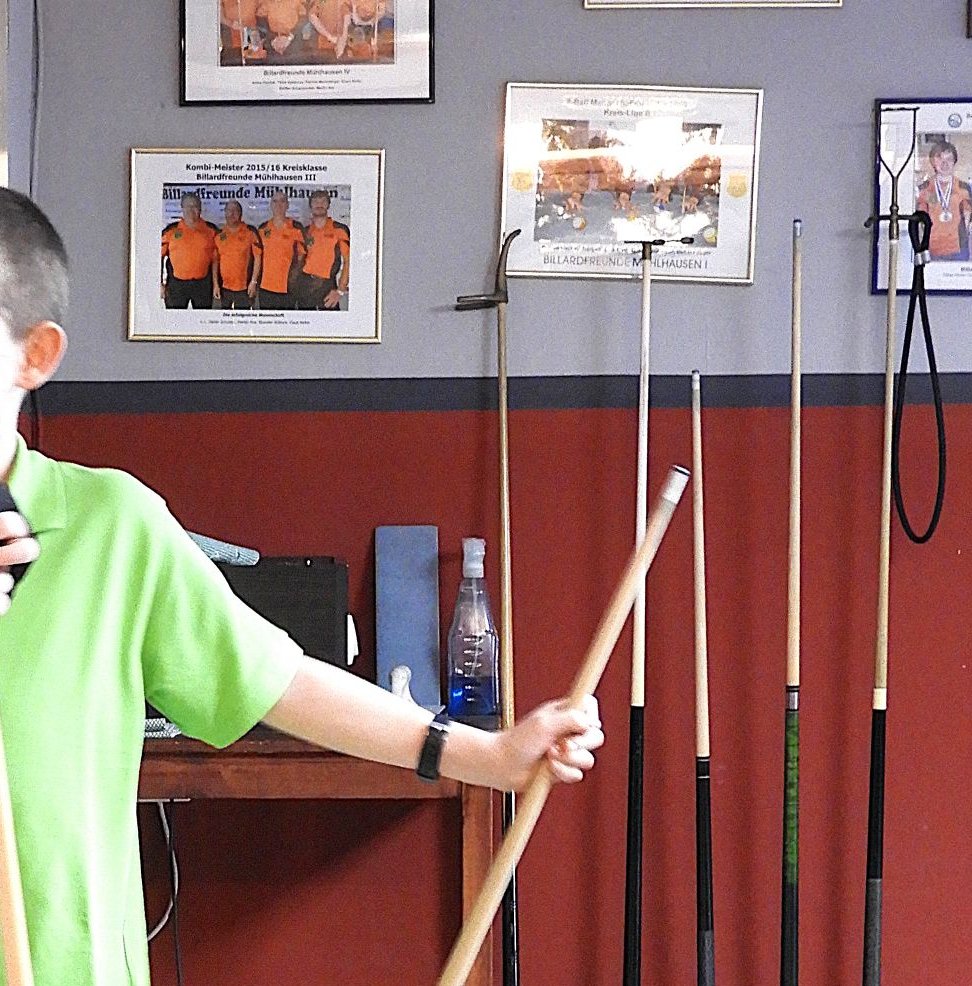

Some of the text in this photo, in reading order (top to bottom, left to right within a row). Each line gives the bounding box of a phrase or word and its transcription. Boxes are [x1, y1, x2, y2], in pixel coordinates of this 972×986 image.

[185, 163, 327, 172] Kombi-Meister 2015/16 Kreisklasse
[196, 173, 253, 181] Billardfreunde
[632, 257, 702, 270] MHLHAUSEN
